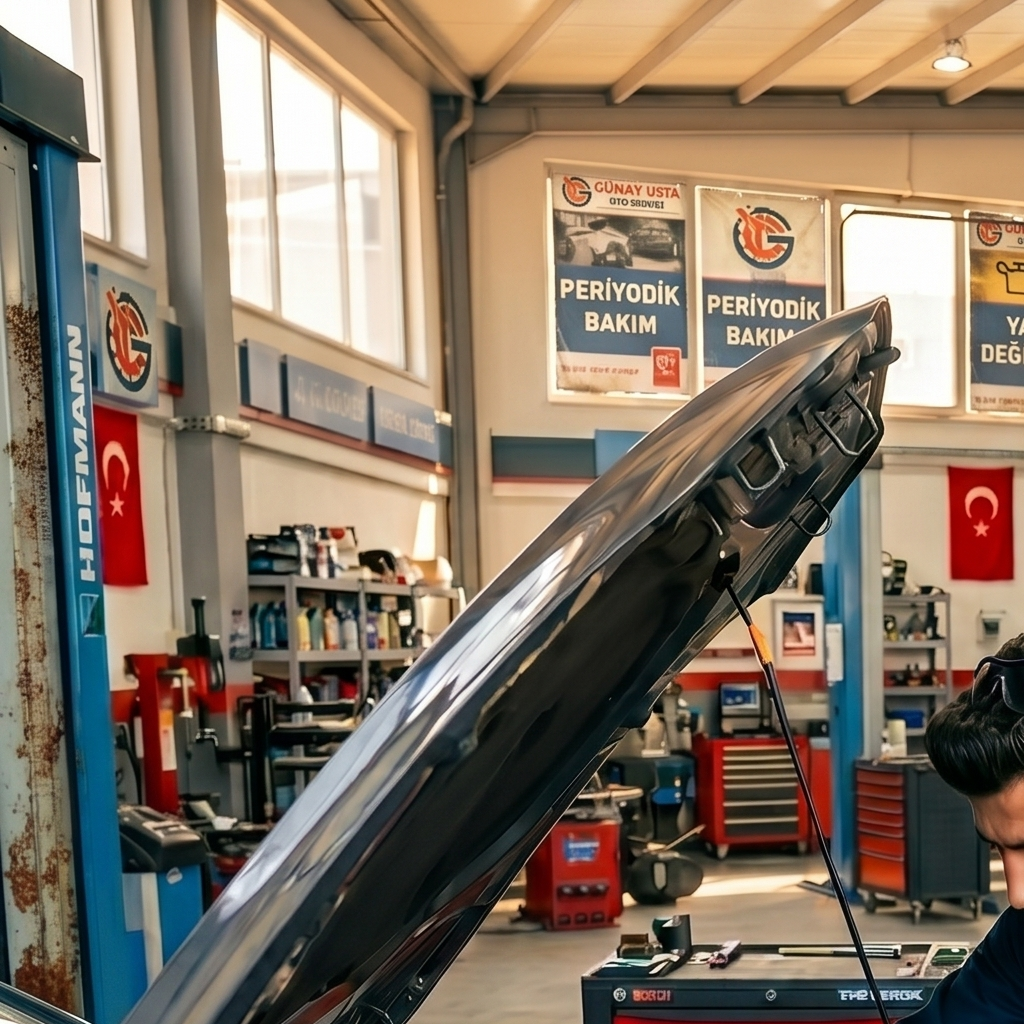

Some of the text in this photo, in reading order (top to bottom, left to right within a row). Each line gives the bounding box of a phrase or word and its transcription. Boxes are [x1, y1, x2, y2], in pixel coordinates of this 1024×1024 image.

[646, 185, 681, 199] USTA
[560, 277, 680, 306] PERİYODİK
[707, 293, 821, 321] PERİYODİK
[584, 312, 657, 335] BAKIM
[67, 324, 96, 582] HOFMANN
